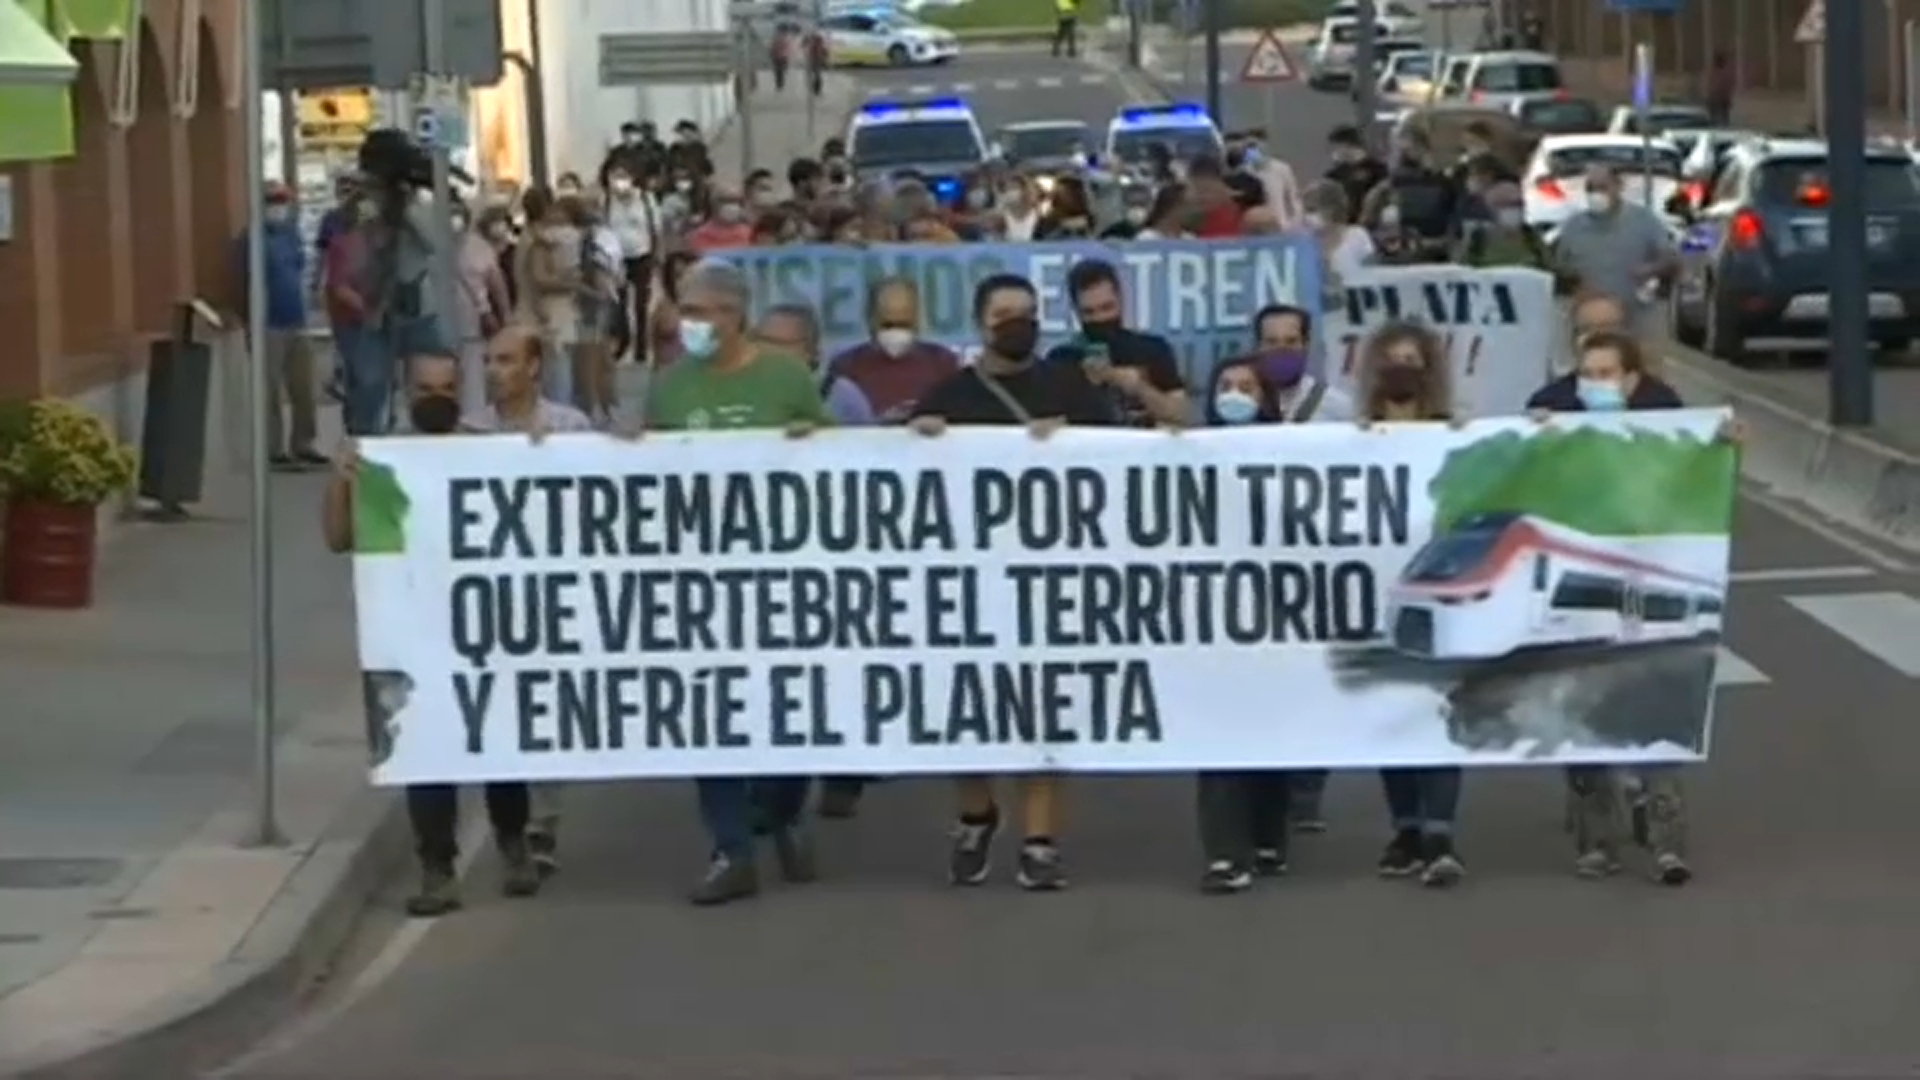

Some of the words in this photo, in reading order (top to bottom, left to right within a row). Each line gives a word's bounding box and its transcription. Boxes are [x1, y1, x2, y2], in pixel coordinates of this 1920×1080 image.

[1124, 247, 1297, 331] TREN
[1345, 282, 1518, 325] PLATA
[449, 468, 957, 560] EXTREMADURA
[973, 466, 1108, 551] POR
[1125, 465, 1218, 548] UN
[1236, 464, 1410, 547] TREN
[450, 572, 582, 667] QUE
[592, 567, 912, 653] VERTEBRE
[925, 566, 996, 648] EL
[1005, 560, 1378, 647] TERRITORIO
[452, 671, 495, 754] Y
[769, 663, 844, 747] EL
[863, 659, 1163, 744] PLANETA
